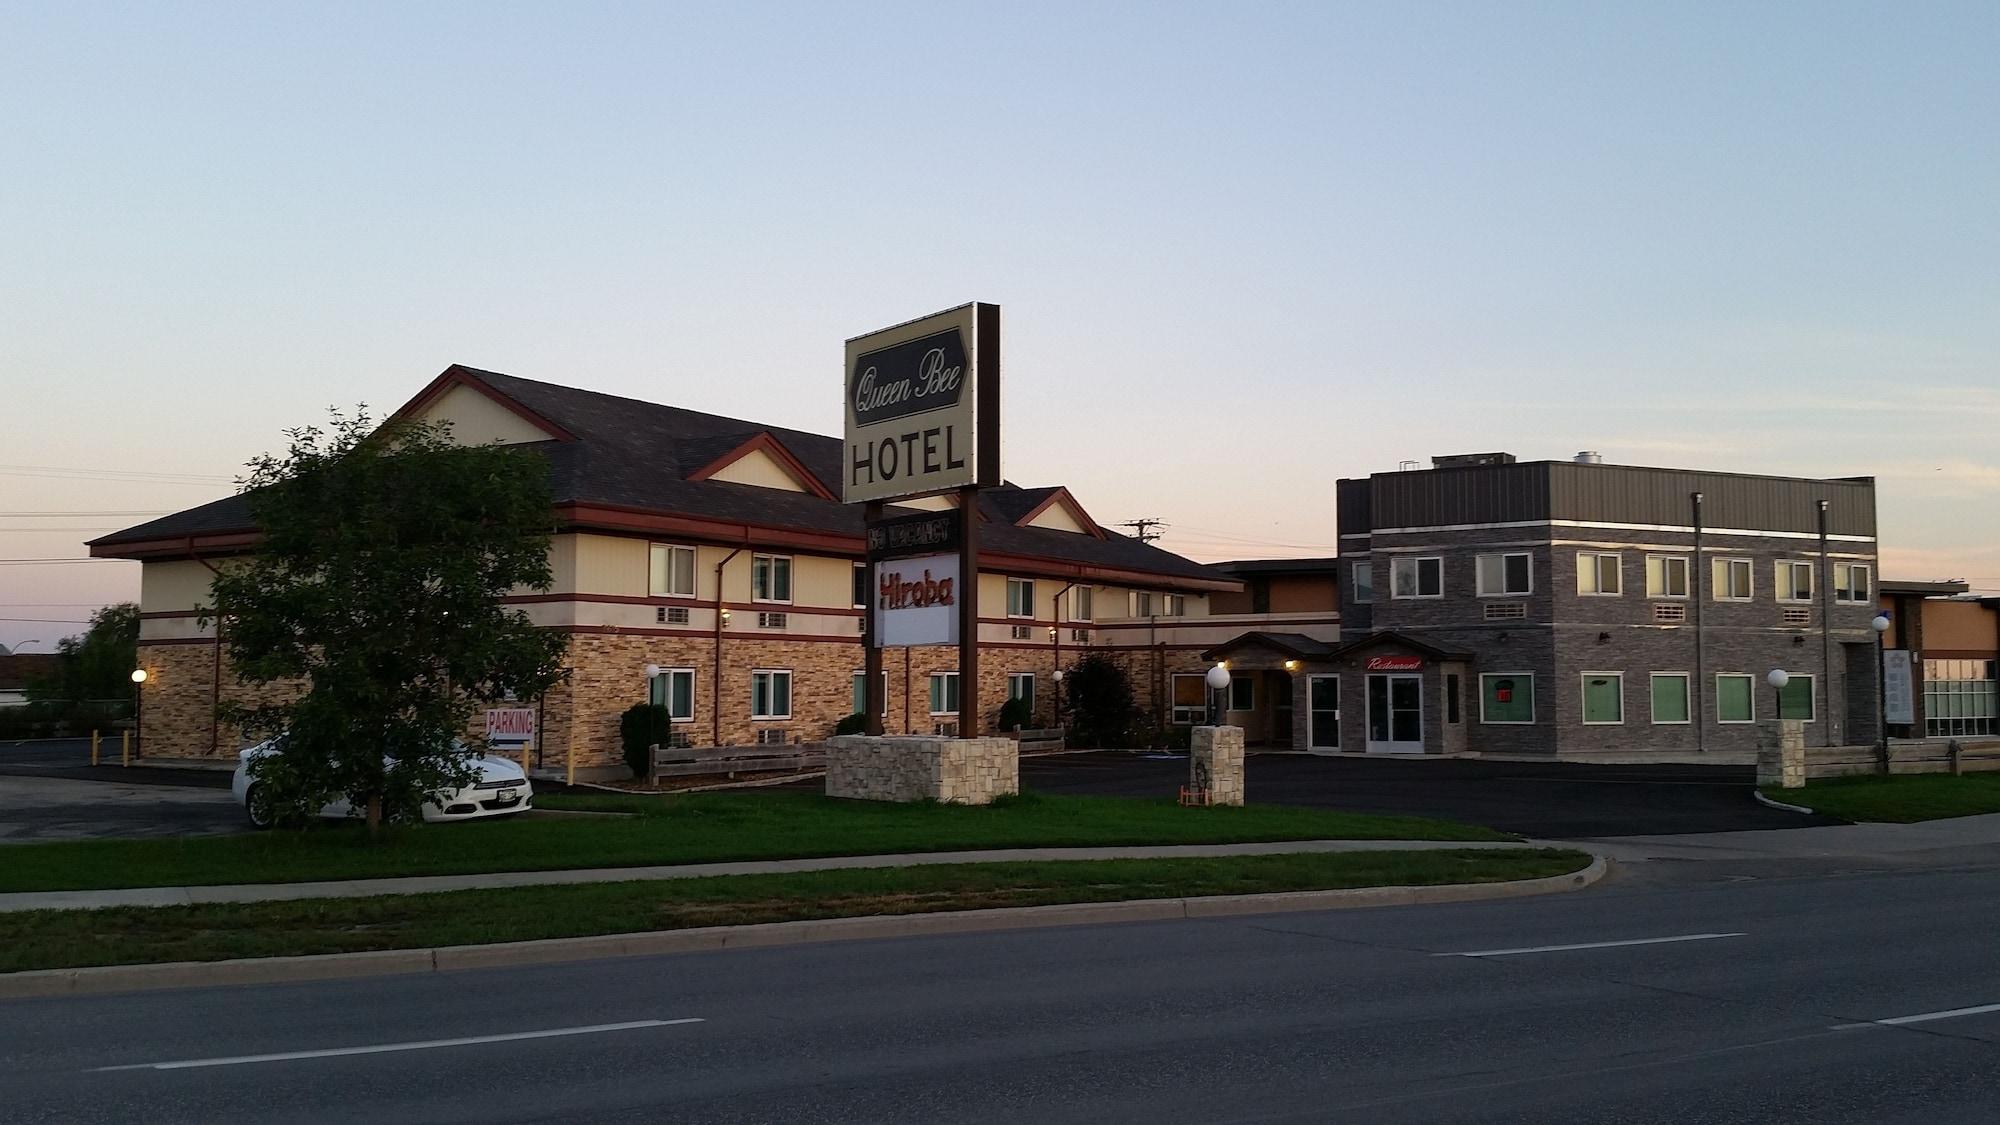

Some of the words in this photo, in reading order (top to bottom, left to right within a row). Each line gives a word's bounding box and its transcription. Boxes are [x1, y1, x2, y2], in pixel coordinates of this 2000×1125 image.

[856, 366, 912, 412] Queen
[914, 347, 961, 398] Bee
[852, 425, 965, 486] HOTEL
[1367, 657, 1422, 670] Restaurant
[487, 711, 533, 734] PARKING
